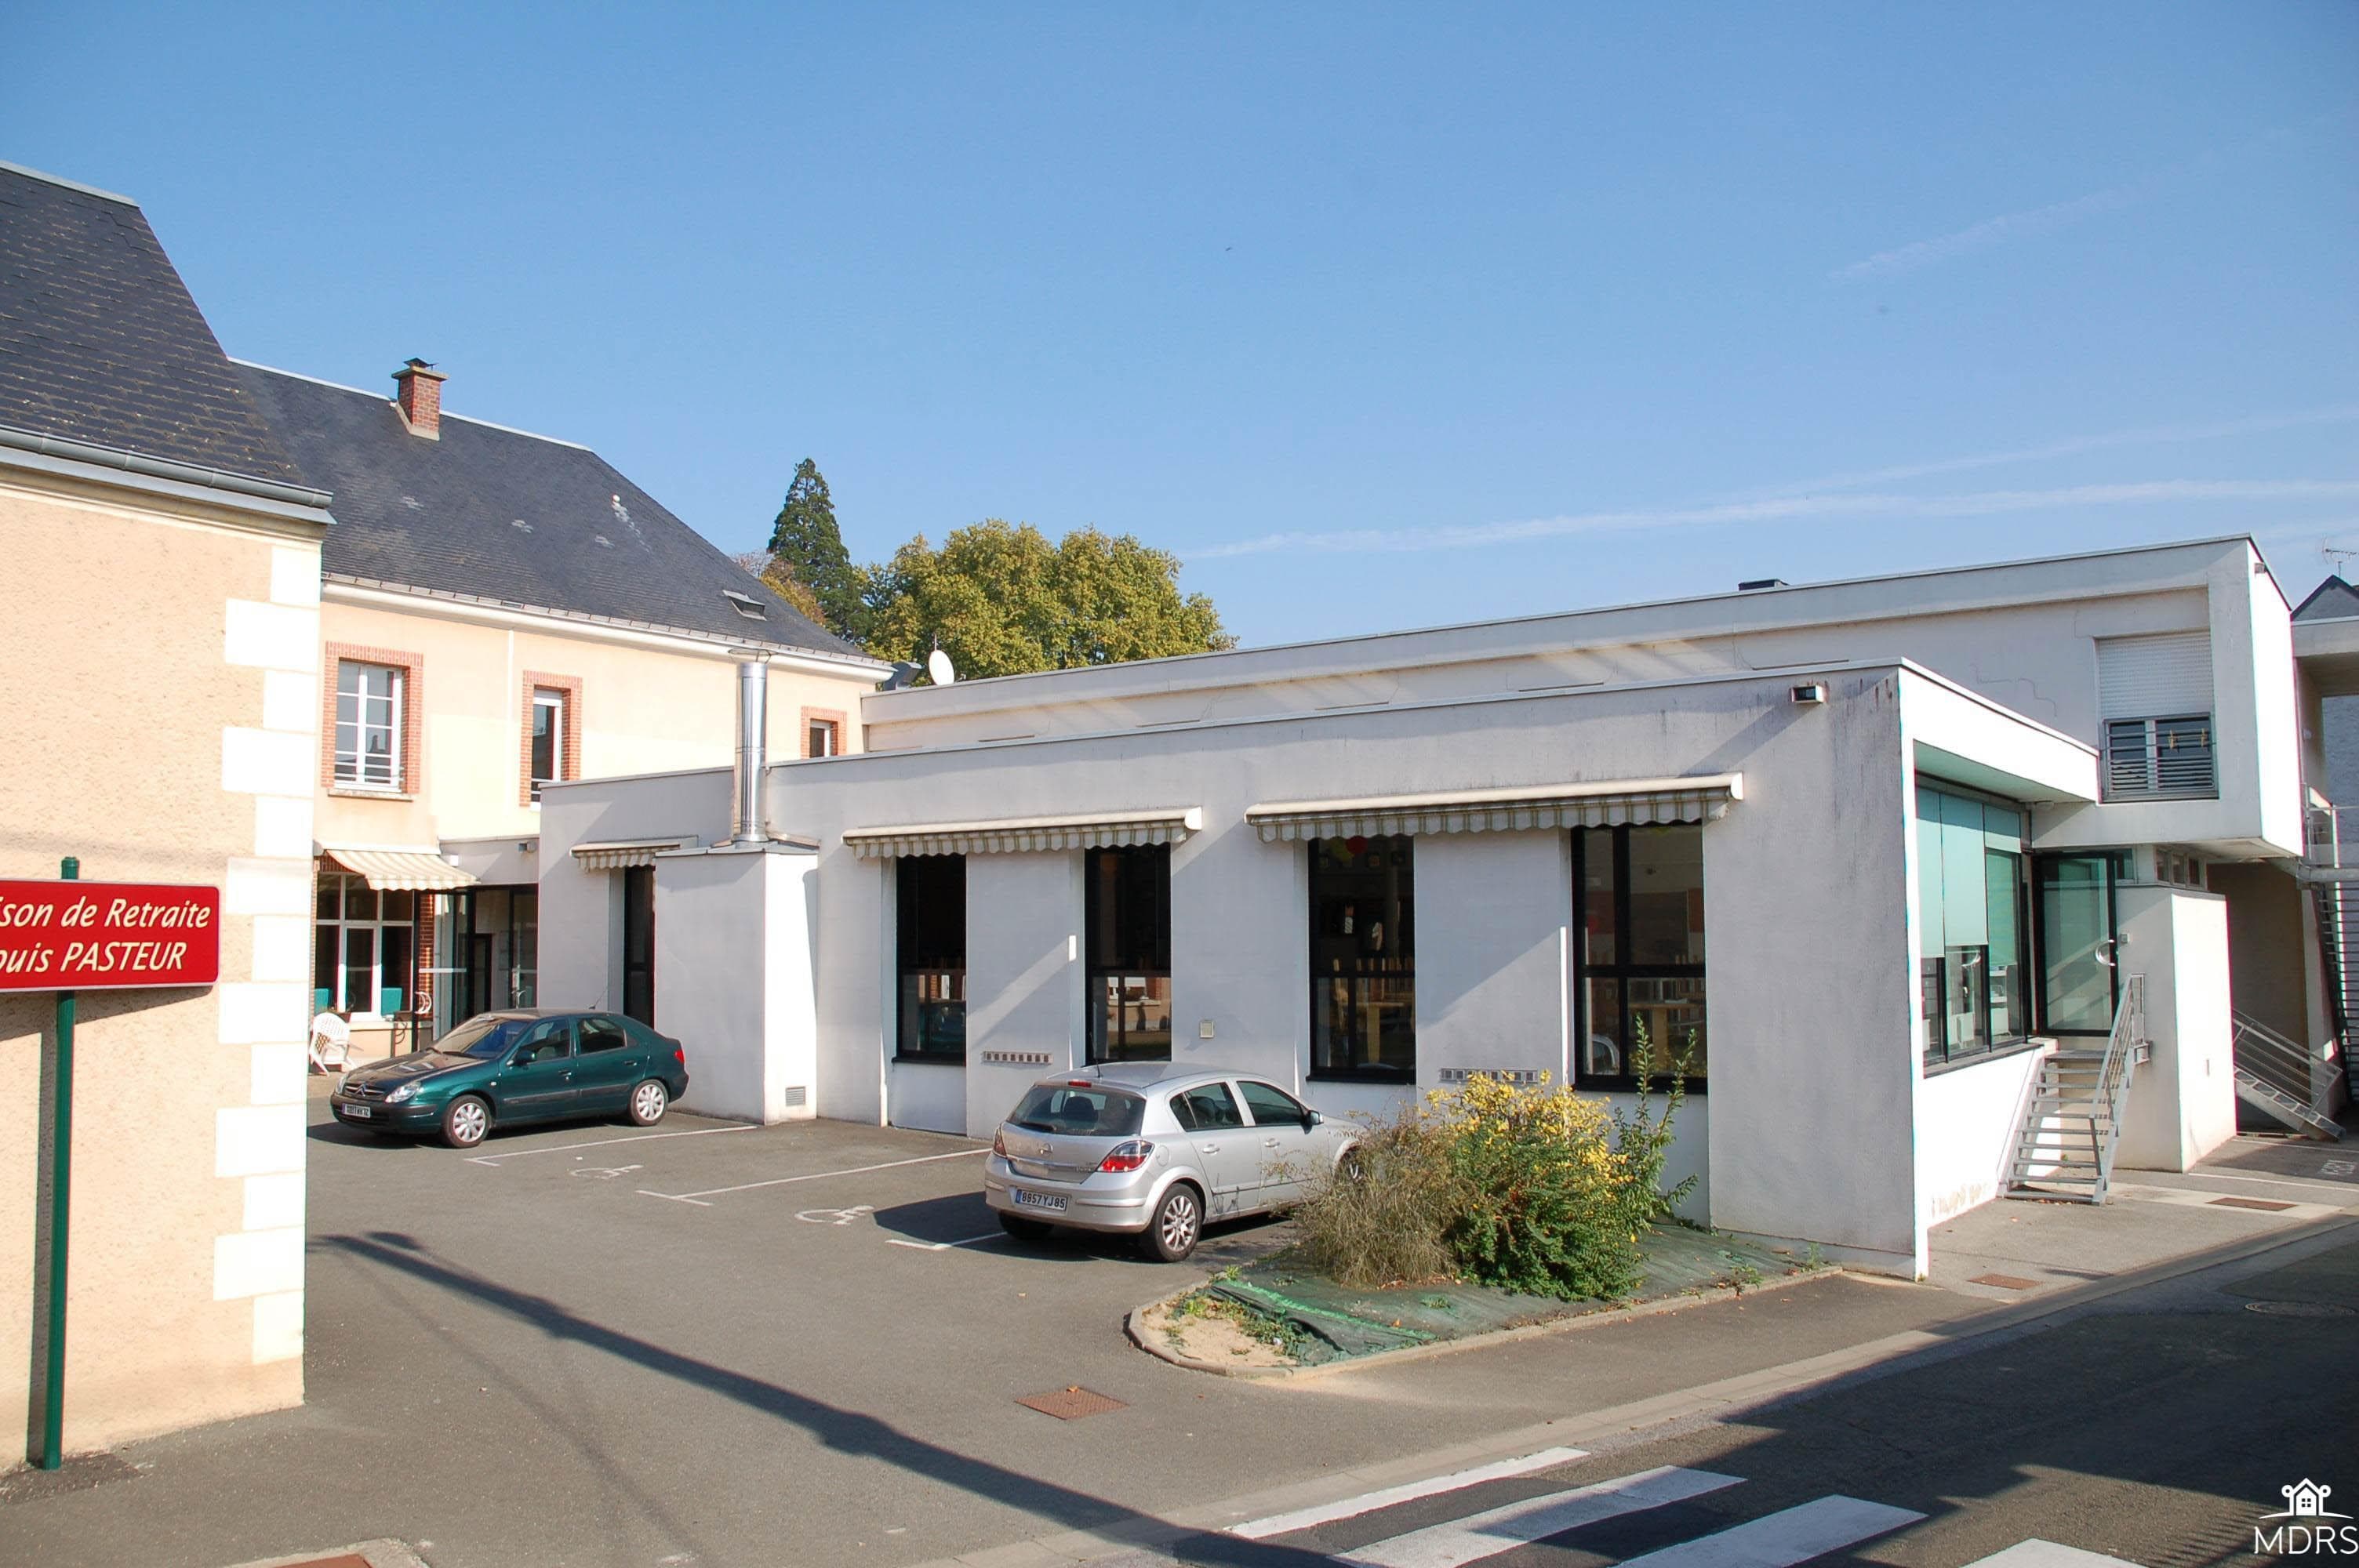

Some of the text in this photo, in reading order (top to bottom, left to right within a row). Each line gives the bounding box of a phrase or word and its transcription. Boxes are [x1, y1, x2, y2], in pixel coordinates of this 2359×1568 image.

[0, 895, 211, 928] son de Retraite
[60, 942, 187, 972] PASTEUR
